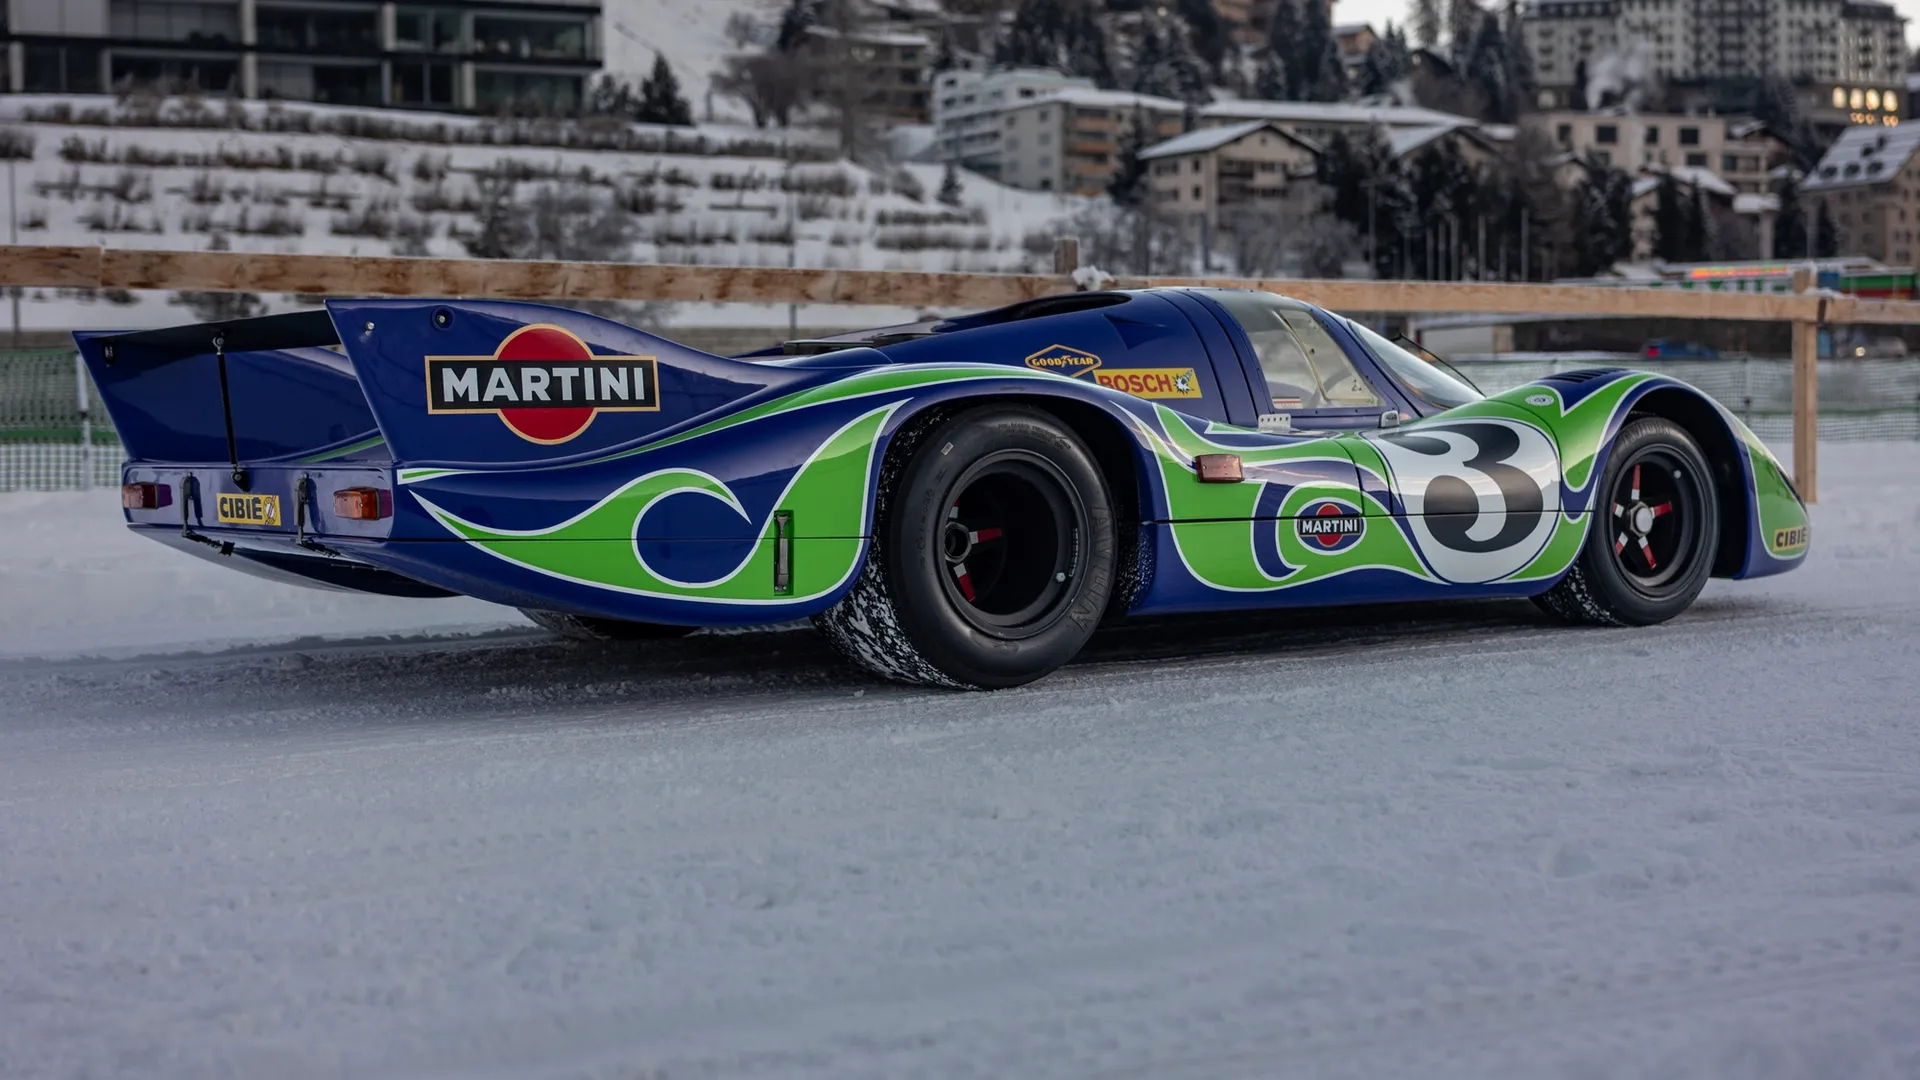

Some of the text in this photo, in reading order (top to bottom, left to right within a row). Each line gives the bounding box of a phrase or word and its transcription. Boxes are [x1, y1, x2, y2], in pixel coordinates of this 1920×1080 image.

[442, 367, 646, 402] MARTINI
[1097, 374, 1173, 393] BOSCH
[1379, 423, 1543, 553] 3
[1302, 519, 1358, 533] MARTINI
